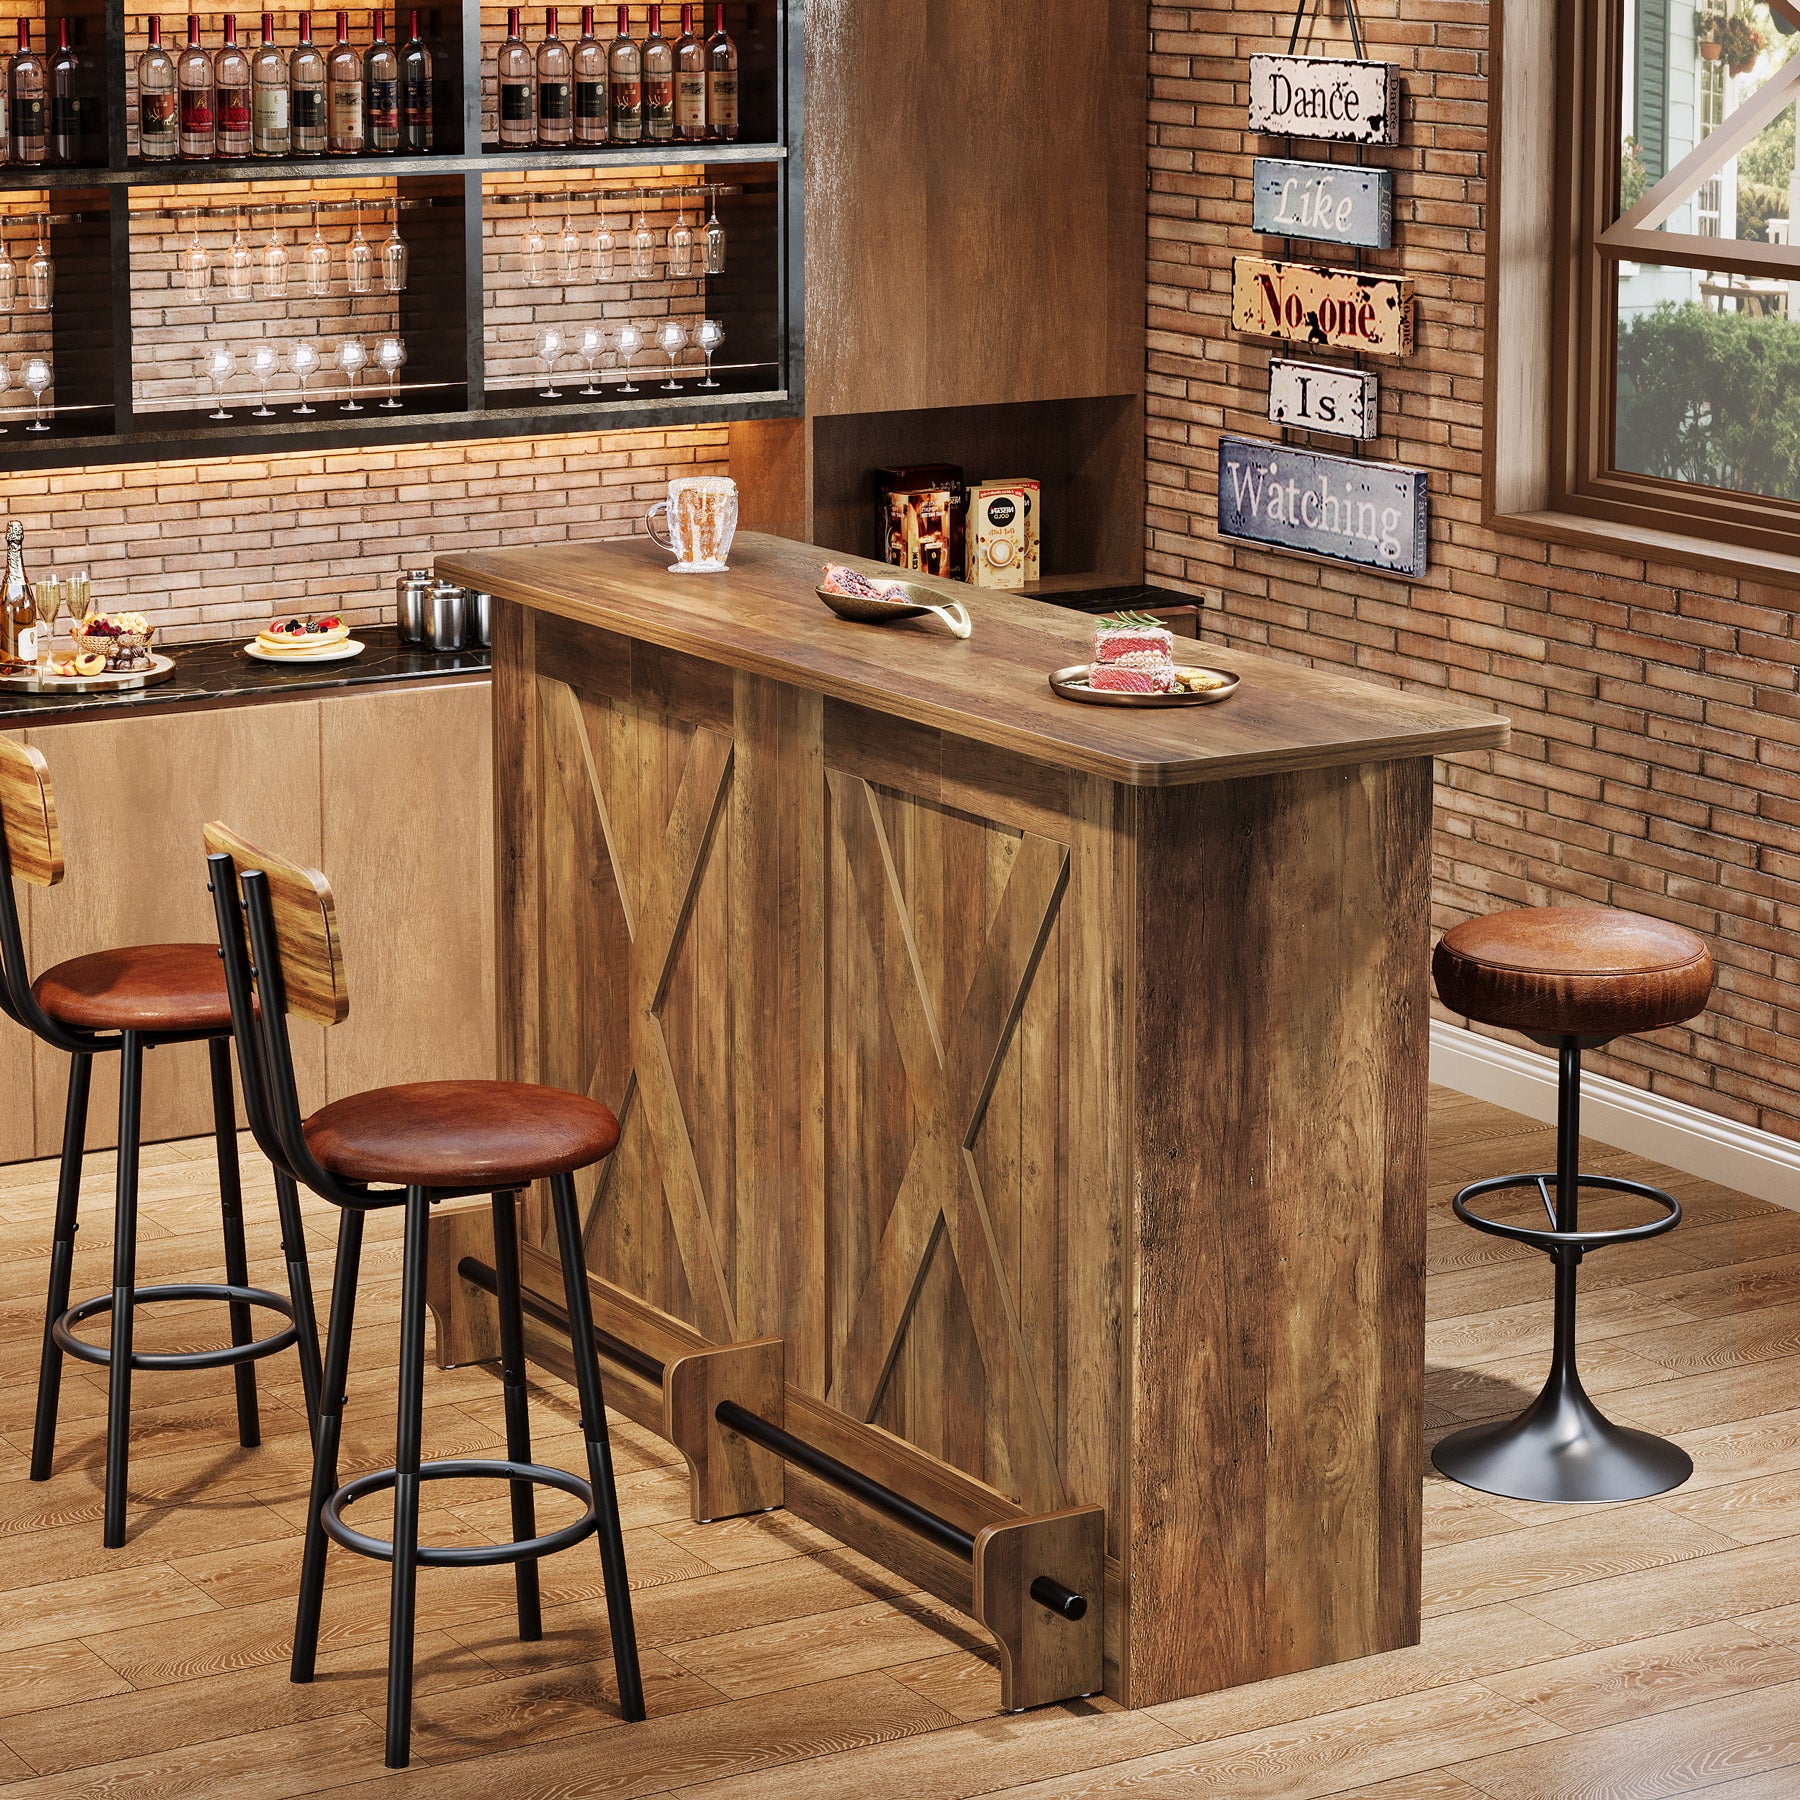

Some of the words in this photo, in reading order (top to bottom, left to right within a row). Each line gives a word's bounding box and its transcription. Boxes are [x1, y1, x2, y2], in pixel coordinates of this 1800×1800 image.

[1268, 73, 1360, 122] Dance
[1274, 175, 1353, 233] Like
[1381, 186, 1391, 233] Like
[1257, 273, 1303, 328] No
[1318, 297, 1376, 339] one
[1296, 376, 1337, 422] Is
[1227, 461, 1401, 560] Watching
[1415, 480, 1428, 570] Watching
